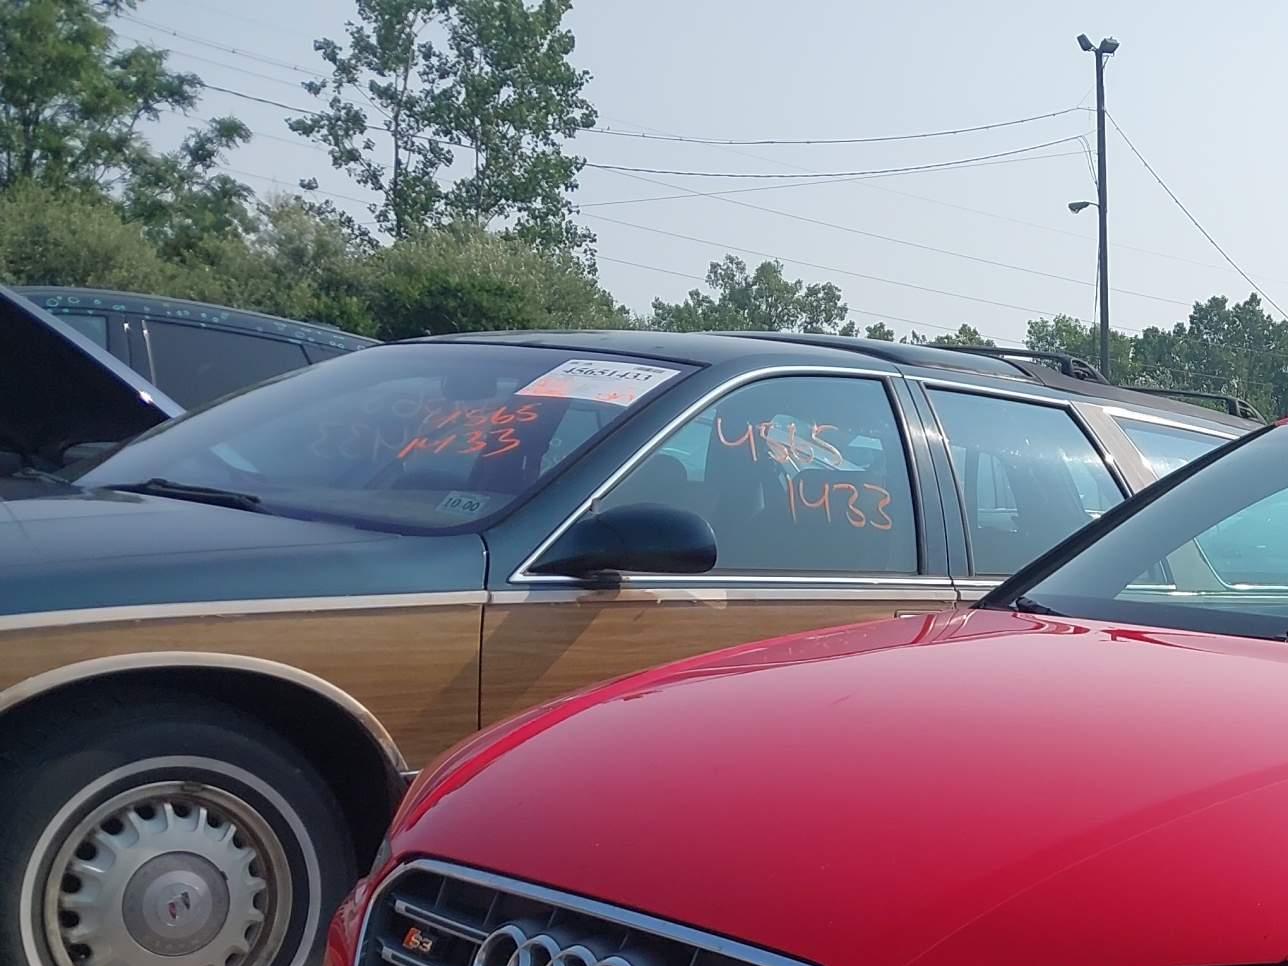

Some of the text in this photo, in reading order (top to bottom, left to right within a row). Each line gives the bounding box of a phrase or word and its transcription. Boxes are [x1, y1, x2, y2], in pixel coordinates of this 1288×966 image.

[562, 366, 652, 382] 45651433
[786, 474, 892, 530] 1433
[403, 927, 433, 952] S3
